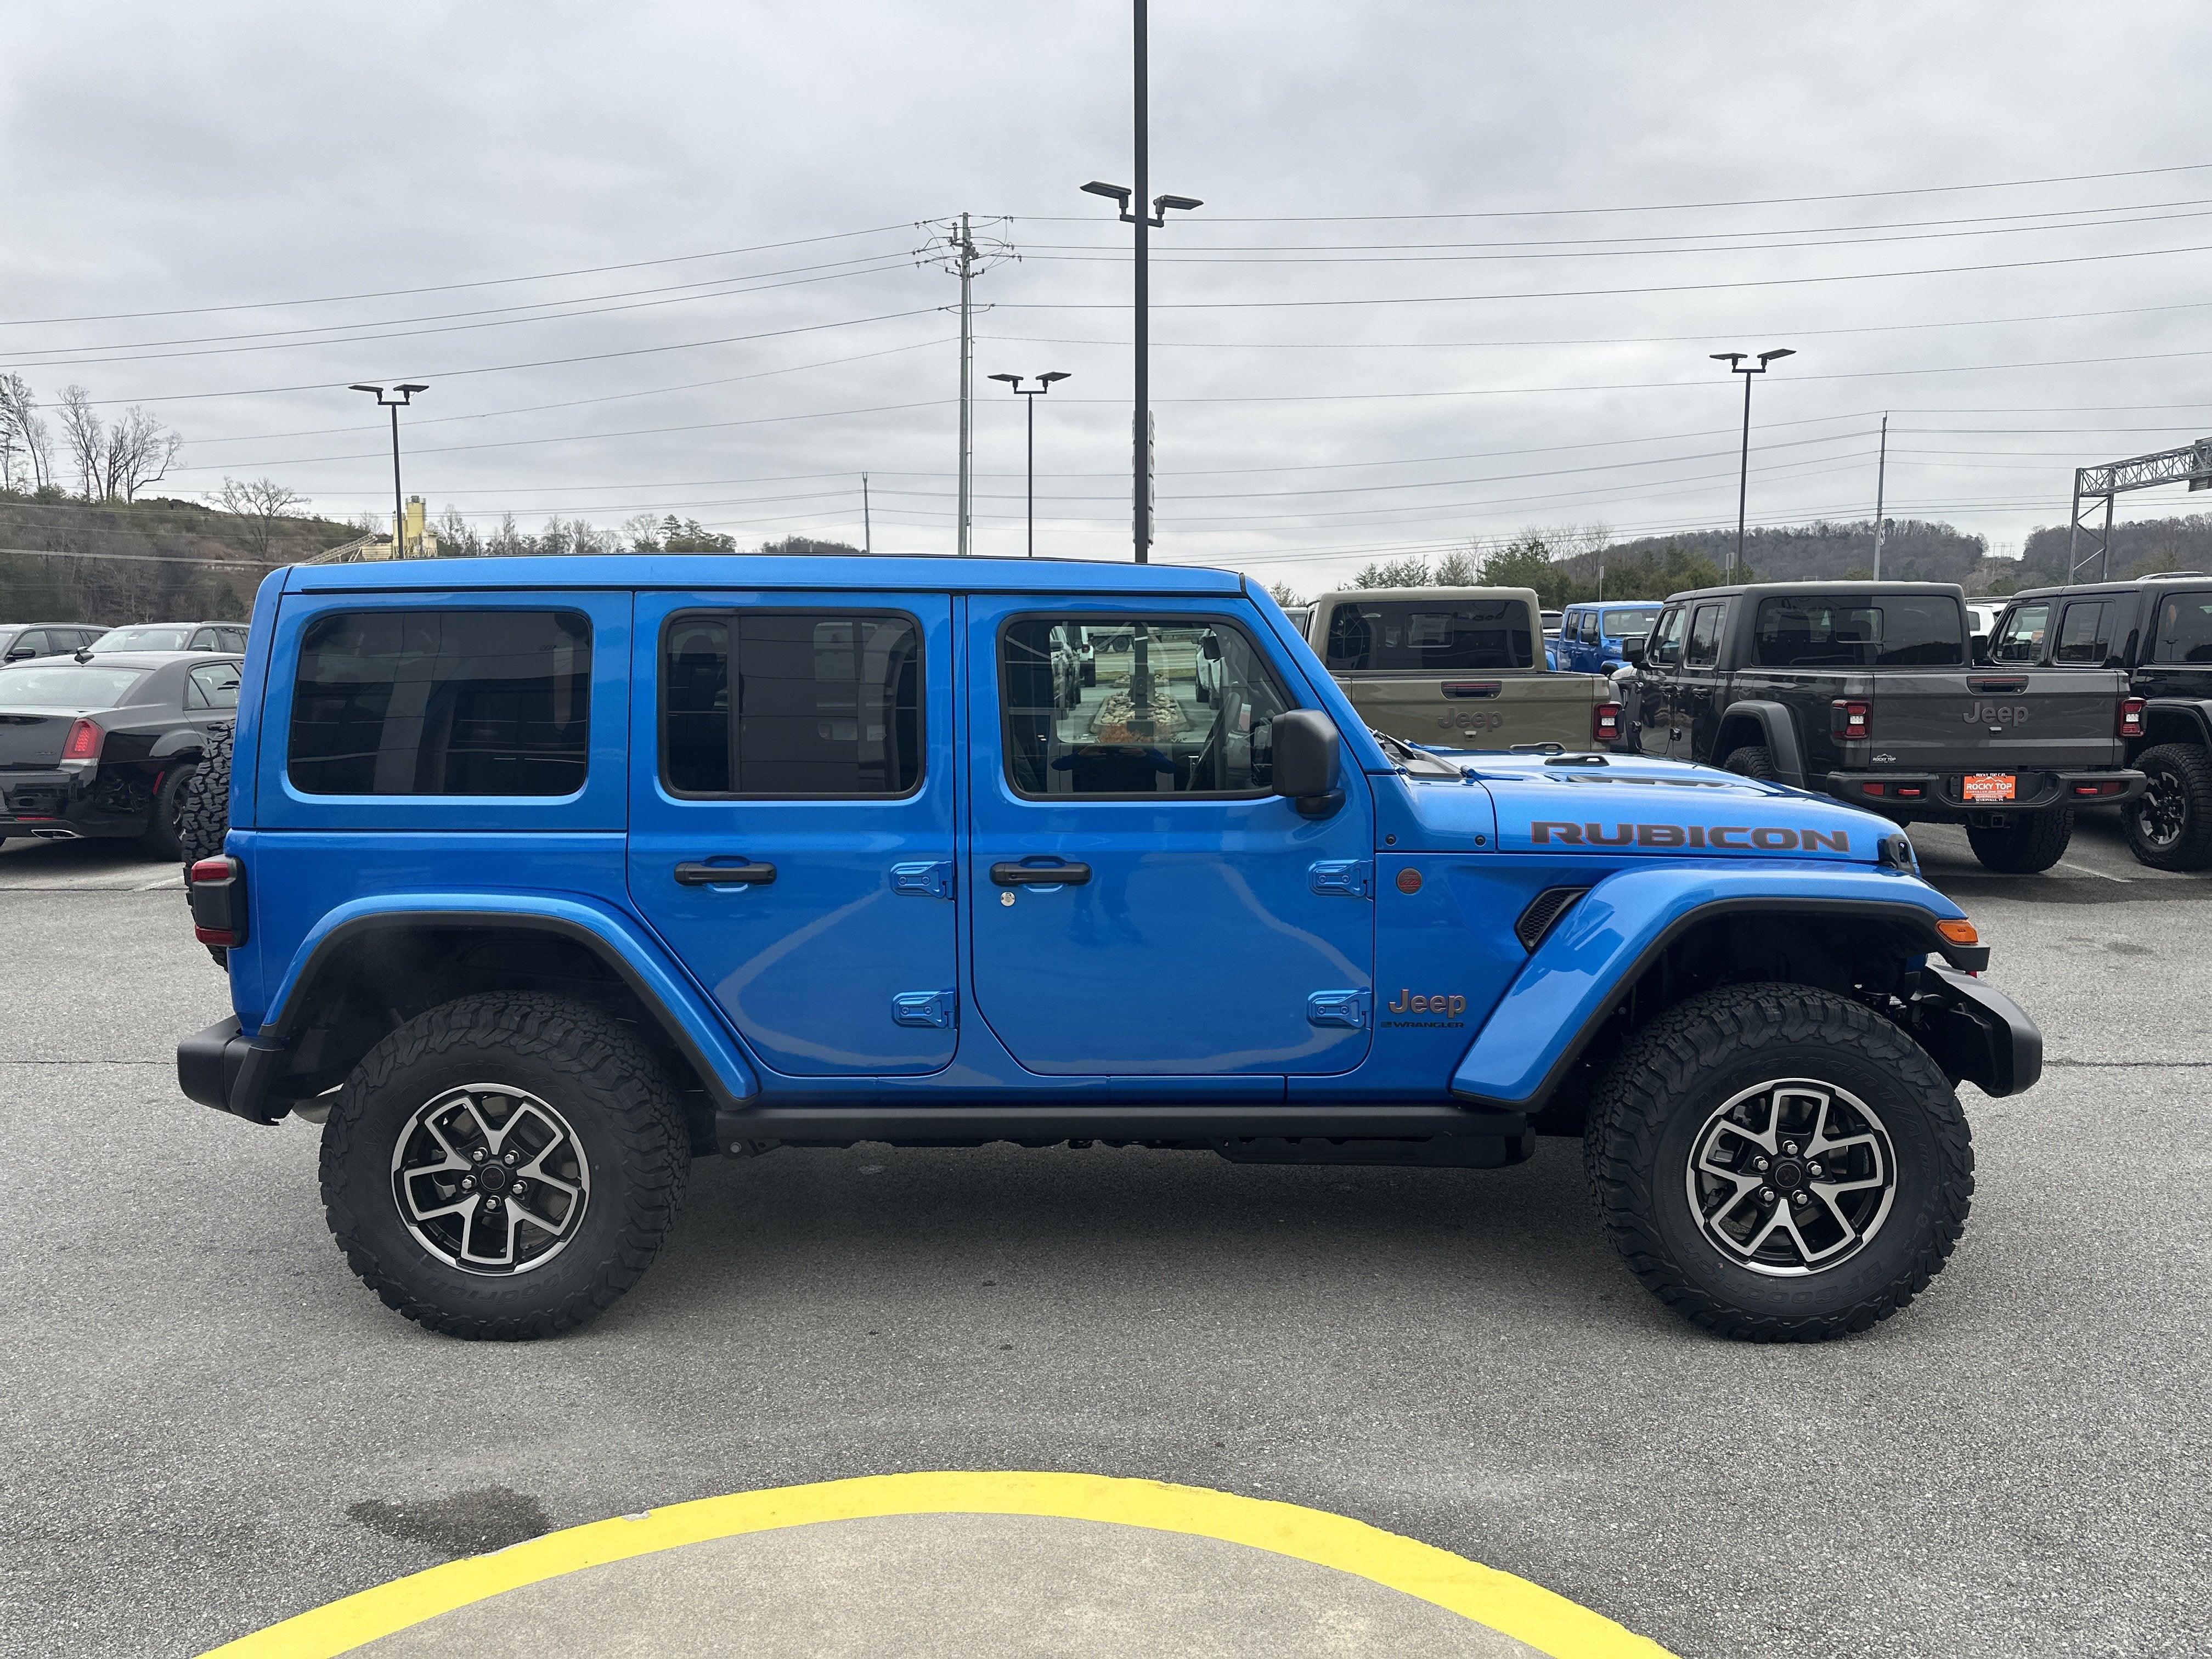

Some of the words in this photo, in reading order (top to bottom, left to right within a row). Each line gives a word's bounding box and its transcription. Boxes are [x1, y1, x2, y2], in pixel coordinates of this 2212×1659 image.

[1437, 707, 1503, 732] Jeep
[1963, 702, 2029, 728] Jeep
[1531, 821, 1850, 853] RUBICON
[1389, 988, 1466, 1019] Jeep
[1682, 1241, 1884, 1305] BFGoodrich
